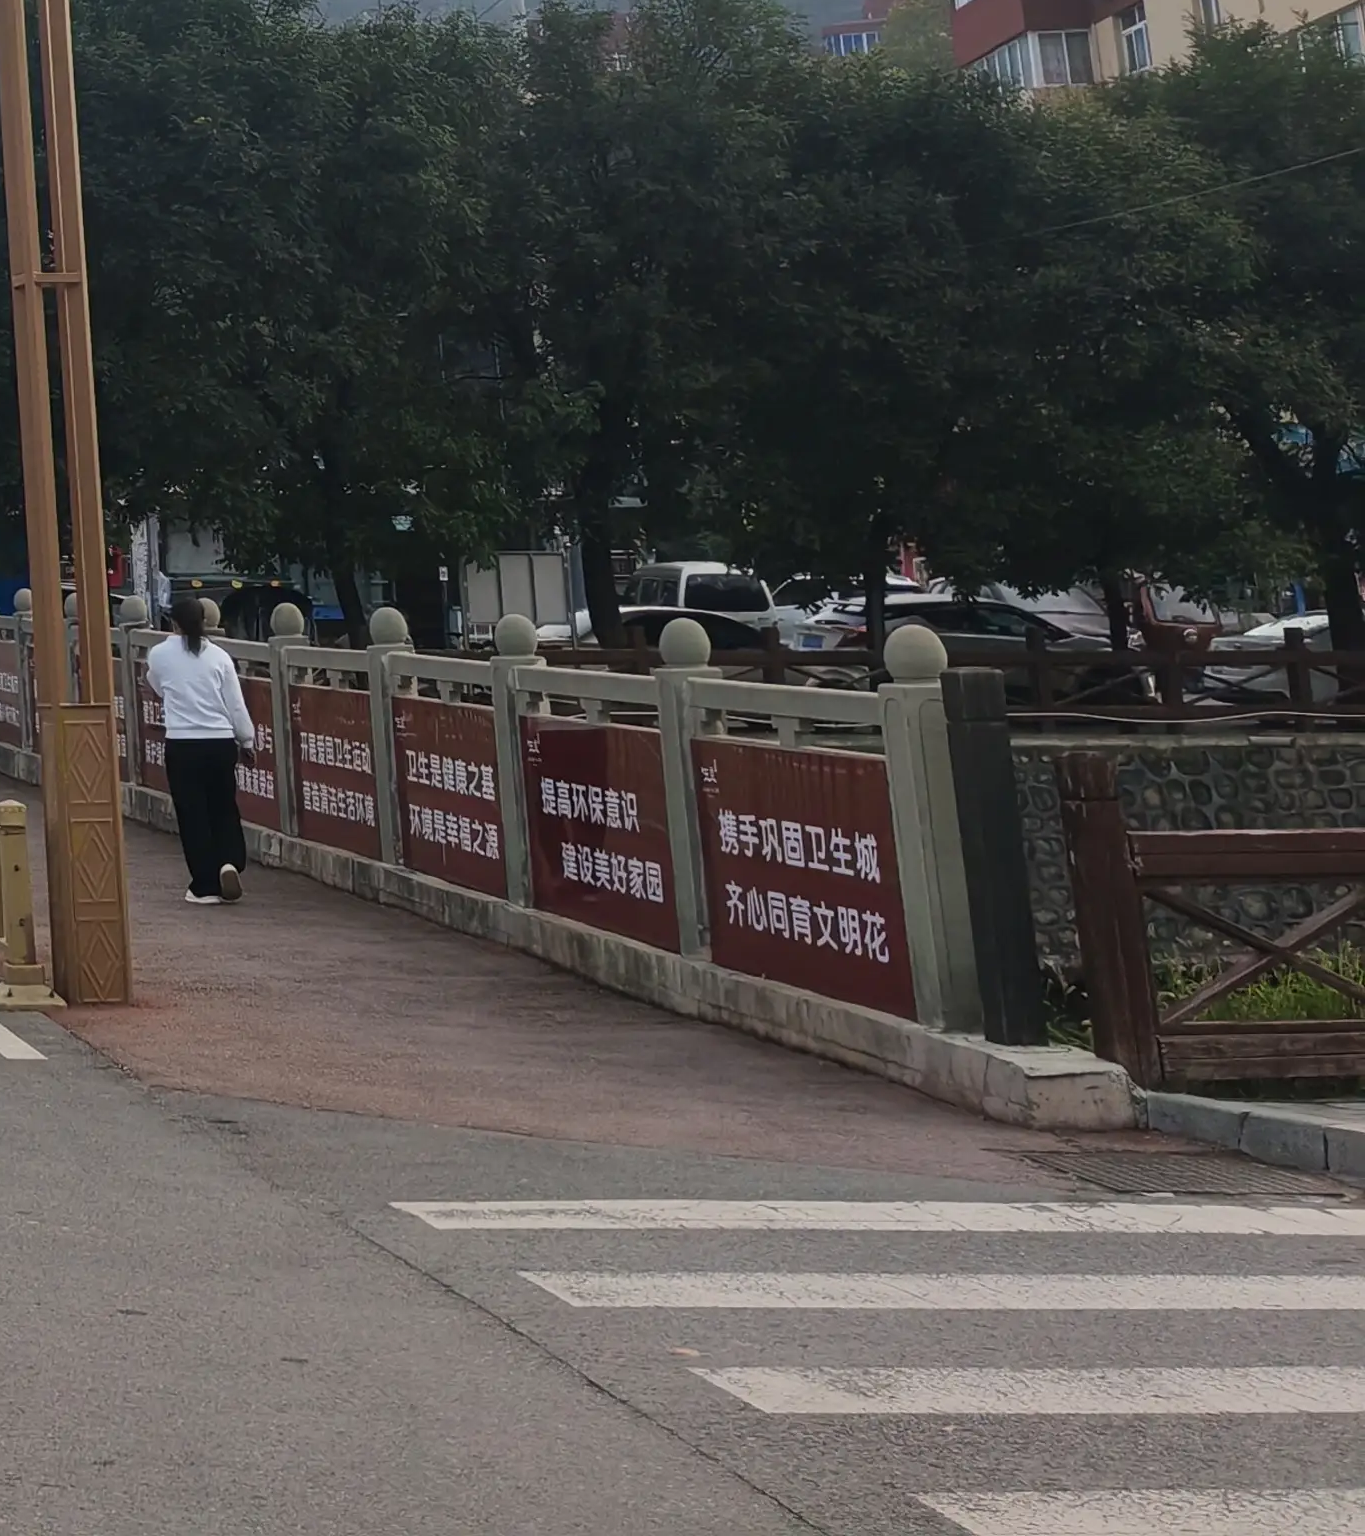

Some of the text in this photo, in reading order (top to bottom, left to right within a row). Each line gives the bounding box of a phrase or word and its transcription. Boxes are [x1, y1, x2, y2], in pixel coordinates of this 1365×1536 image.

[299, 731, 374, 775] 开展爱国卫生运动
[405, 747, 497, 803] 卫生是健康之基
[302, 780, 376, 827] 营造清洁生活环境
[408, 802, 501, 860] 环境是幸福之源
[540, 774, 640, 835] 提高环保意识
[561, 840, 665, 905] 建设美好家园
[718, 807, 882, 885] 携手巩固卫生城
[724, 879, 890, 964] 齐心同育文明花
